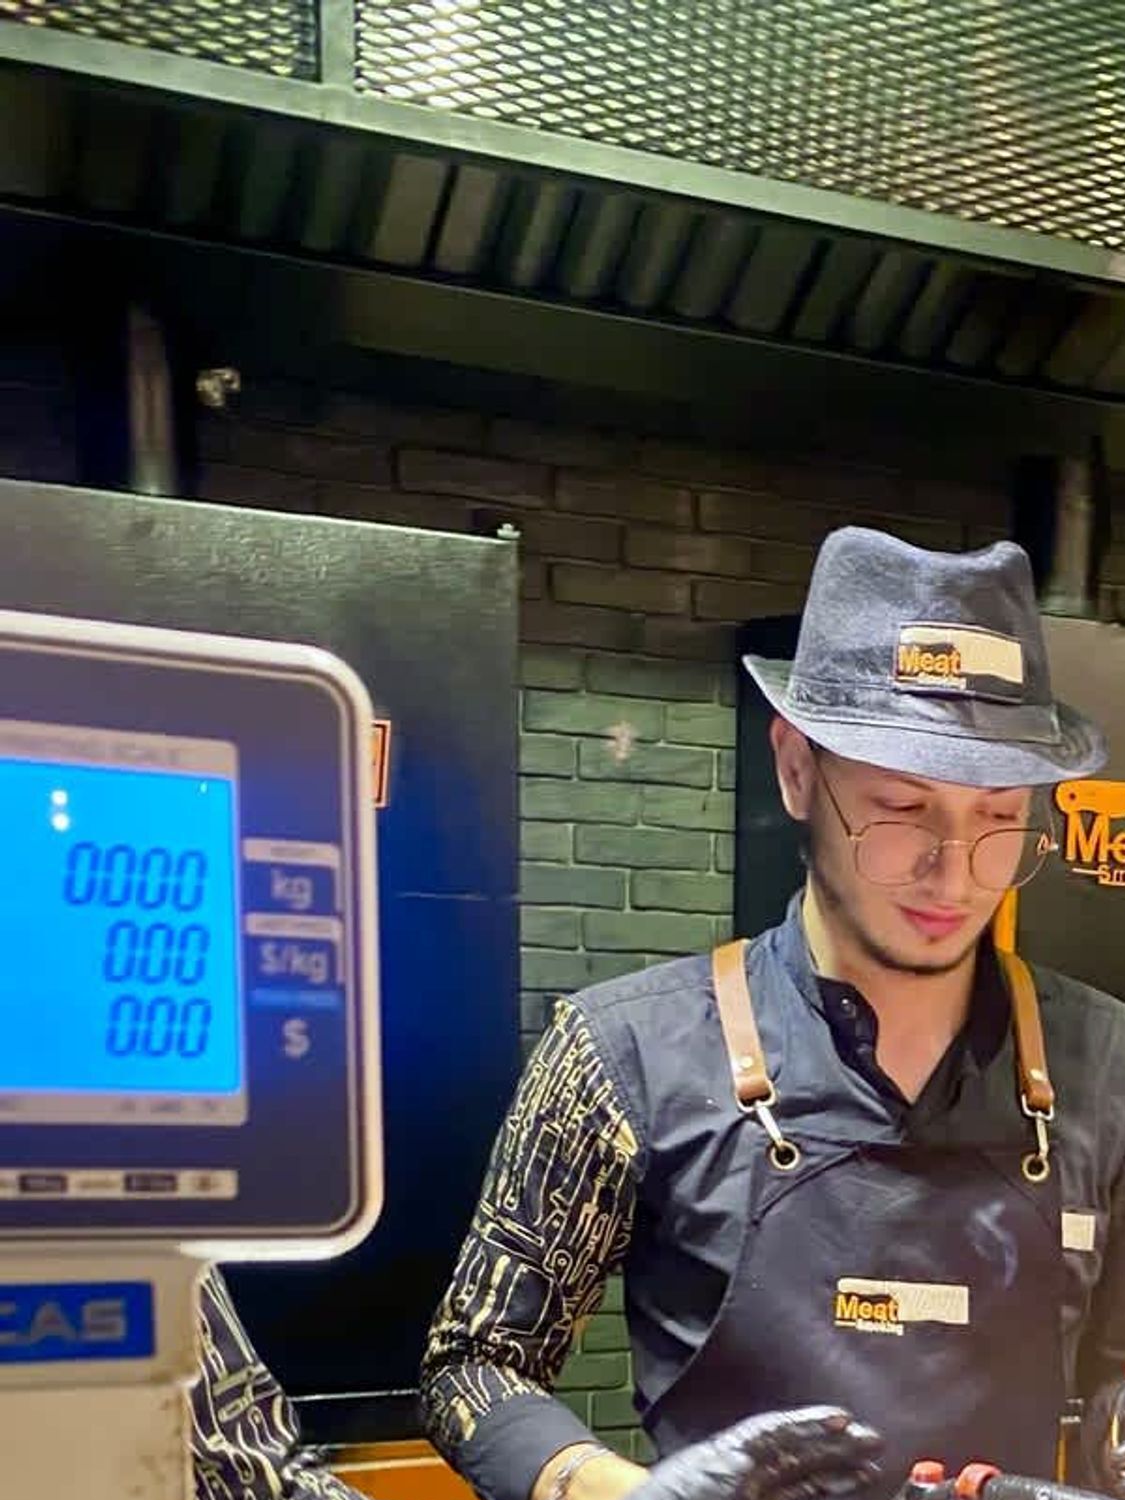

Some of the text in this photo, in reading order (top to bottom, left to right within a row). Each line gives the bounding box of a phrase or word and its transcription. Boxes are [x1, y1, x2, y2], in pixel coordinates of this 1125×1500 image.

[898, 645, 961, 675] Meat
[270, 868, 312, 911] kg
[836, 1293, 899, 1321] Meat
